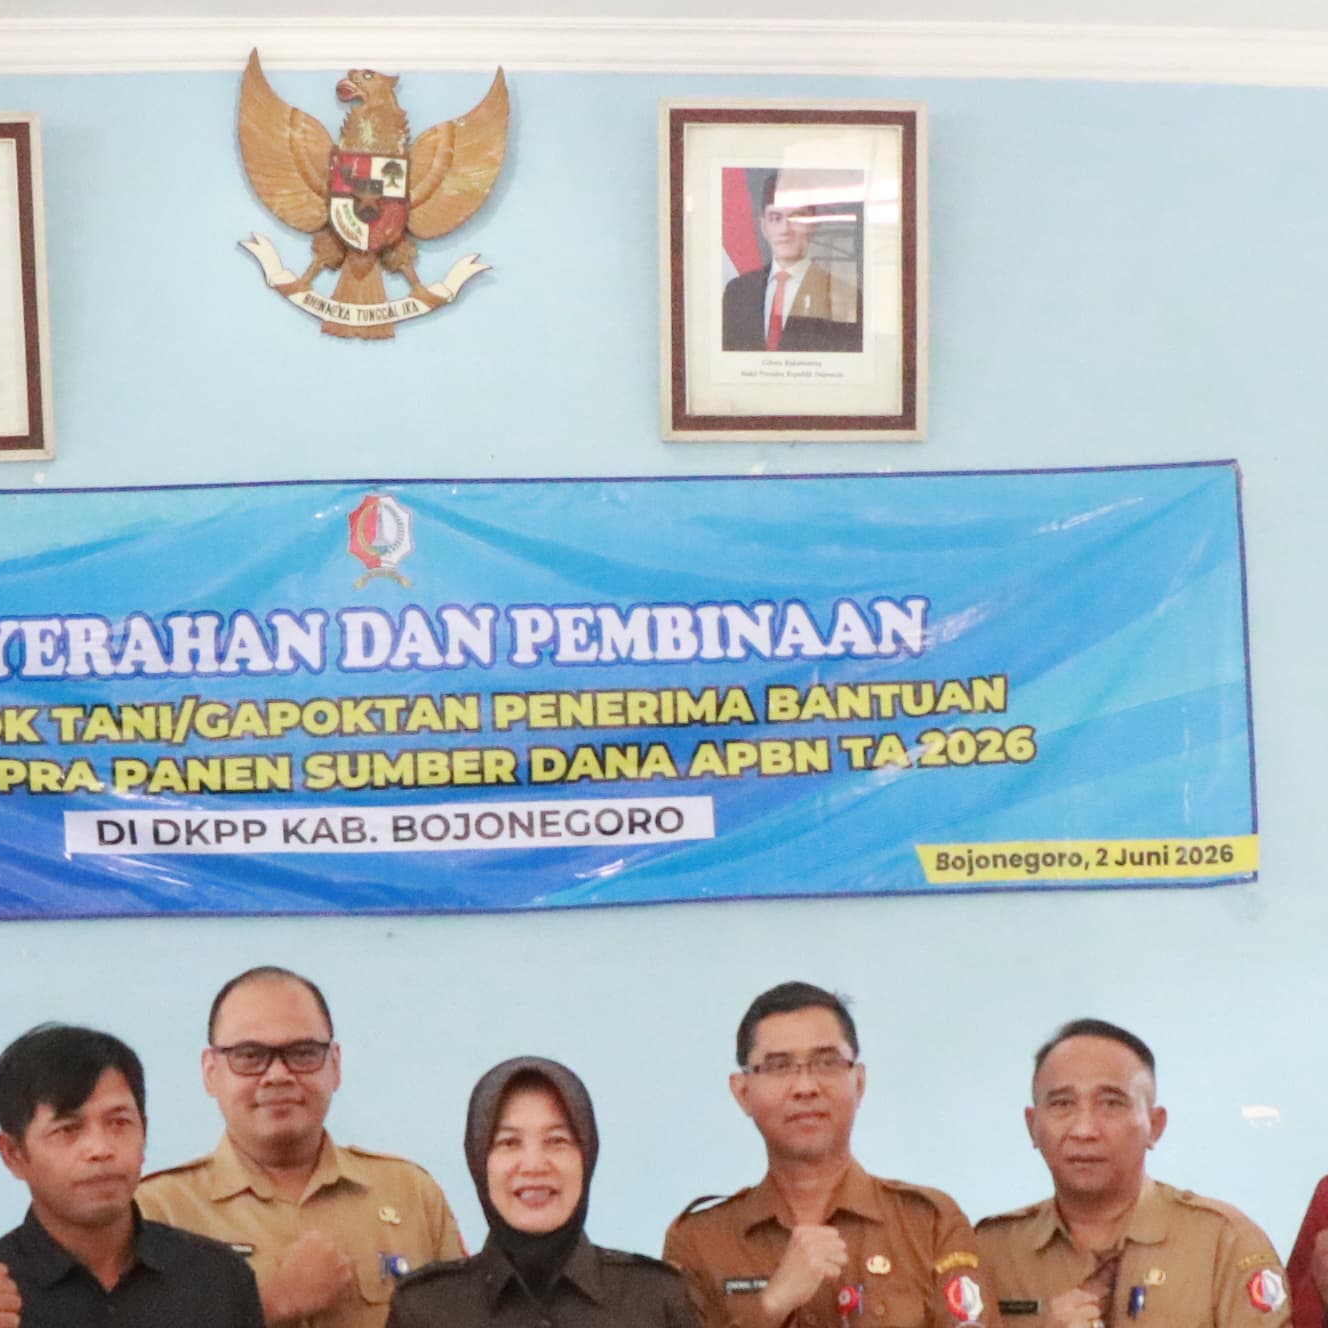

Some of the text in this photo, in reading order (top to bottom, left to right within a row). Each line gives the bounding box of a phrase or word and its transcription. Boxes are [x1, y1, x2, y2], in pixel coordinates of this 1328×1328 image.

[402, 300, 420, 315] IKA
[340, 606, 497, 670] DAN
[509, 598, 932, 666] PEMBINAAN
[50, 695, 482, 745] TANI/GAPOKTAN
[493, 687, 756, 731] PENERIMA
[767, 676, 1007, 723] BANTUAN
[113, 755, 293, 795] PANEN
[304, 748, 518, 791] SUMBER
[530, 744, 679, 784] DANA
[689, 738, 831, 778] APBN
[840, 734, 914, 770] TA
[921, 726, 1037, 767] 2026
[96, 807, 684, 847] DI DKPP KAB. BOJONEGORO
[936, 845, 1235, 878] Bojonegoro, 2 Juni 2026
